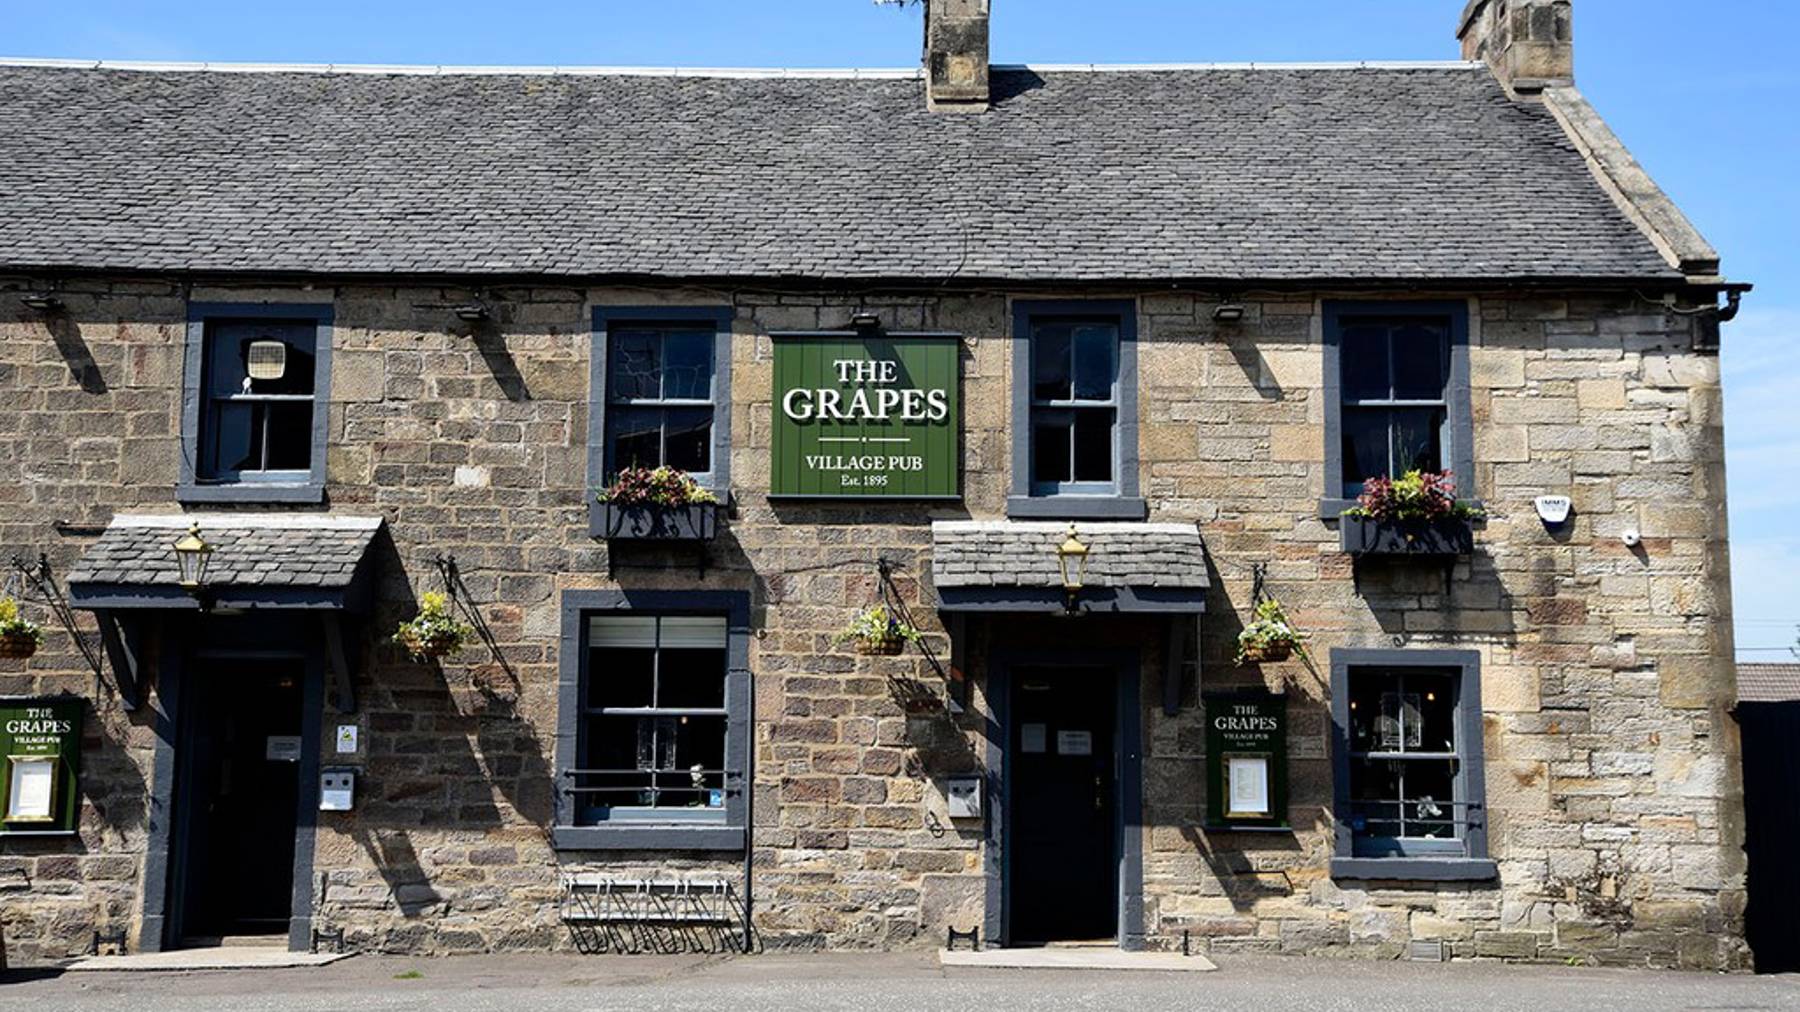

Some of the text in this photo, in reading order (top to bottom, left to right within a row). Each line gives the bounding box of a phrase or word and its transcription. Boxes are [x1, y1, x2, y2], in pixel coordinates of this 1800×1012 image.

[833, 360, 898, 382] THE
[783, 388, 948, 419] GRAPES
[805, 456, 923, 470] VILLAGE PUB
[841, 475, 888, 486] Est. 1895
[26, 708, 54, 719] THE
[1233, 705, 1259, 715] THE
[6, 720, 72, 734] GRAPES
[1214, 716, 1278, 730] GRAPES
